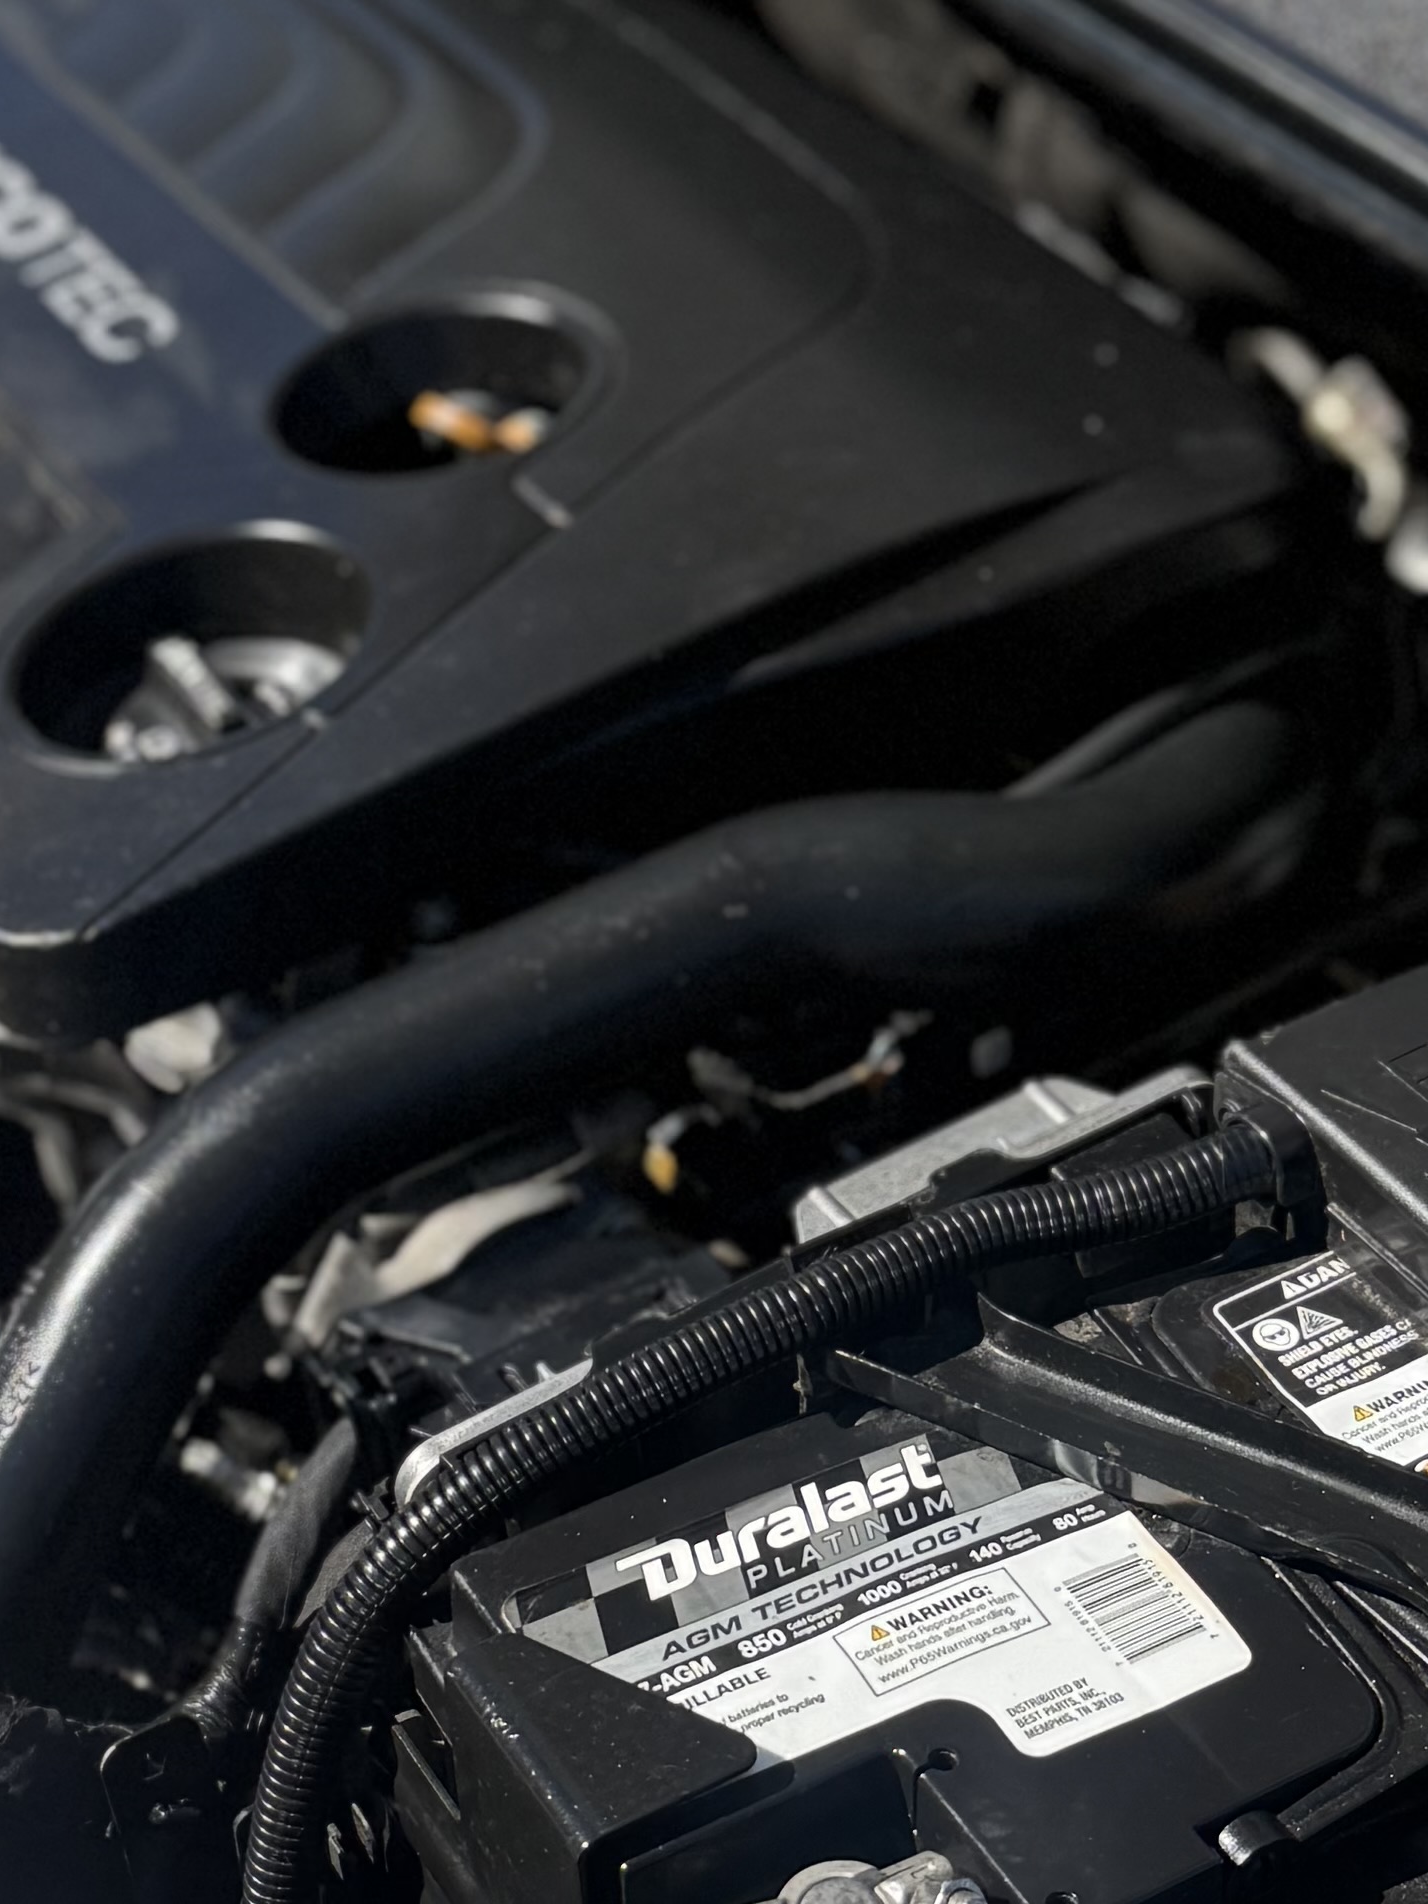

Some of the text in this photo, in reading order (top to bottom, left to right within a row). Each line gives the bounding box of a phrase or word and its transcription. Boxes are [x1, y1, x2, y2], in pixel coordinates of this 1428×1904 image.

[1277, 1340, 1322, 1367] SHIELD
[1291, 1340, 1359, 1380] EXPLOSIVE
[1355, 1324, 1398, 1351] GASES
[1304, 1329, 1420, 1389] CAUSE BLINDNESS
[1316, 1382, 1339, 1396] OR
[615, 1444, 943, 1601] Duralast
[746, 1489, 954, 1589] PLATINUM
[1052, 1512, 1078, 1531] 80
[968, 1541, 1003, 1563] 140
[662, 1516, 982, 1661] AGM TECHNOLOGY
[857, 1579, 902, 1606] 1000
[886, 1584, 994, 1631] WARNING:
[737, 1628, 787, 1659] 850
[854, 1639, 894, 1662] Cancer
[896, 1629, 918, 1645] and
[919, 1603, 987, 1635] Reproductive
[873, 1648, 908, 1666] Wash
[908, 1633, 943, 1652] hands
[943, 1623, 968, 1640] after
[877, 1615, 1033, 1684] www.P65Warnings.ca.gov
[728, 1699, 776, 1724] batteries
[778, 1693, 826, 1718] recycling
[1006, 1677, 1089, 1717] DISTRIBUTED BY
[1014, 1710, 1042, 1729] BEST
[1042, 1696, 1082, 1717] PARTS,
[1023, 1692, 1125, 1739] MEMPHIS, TN 38103
